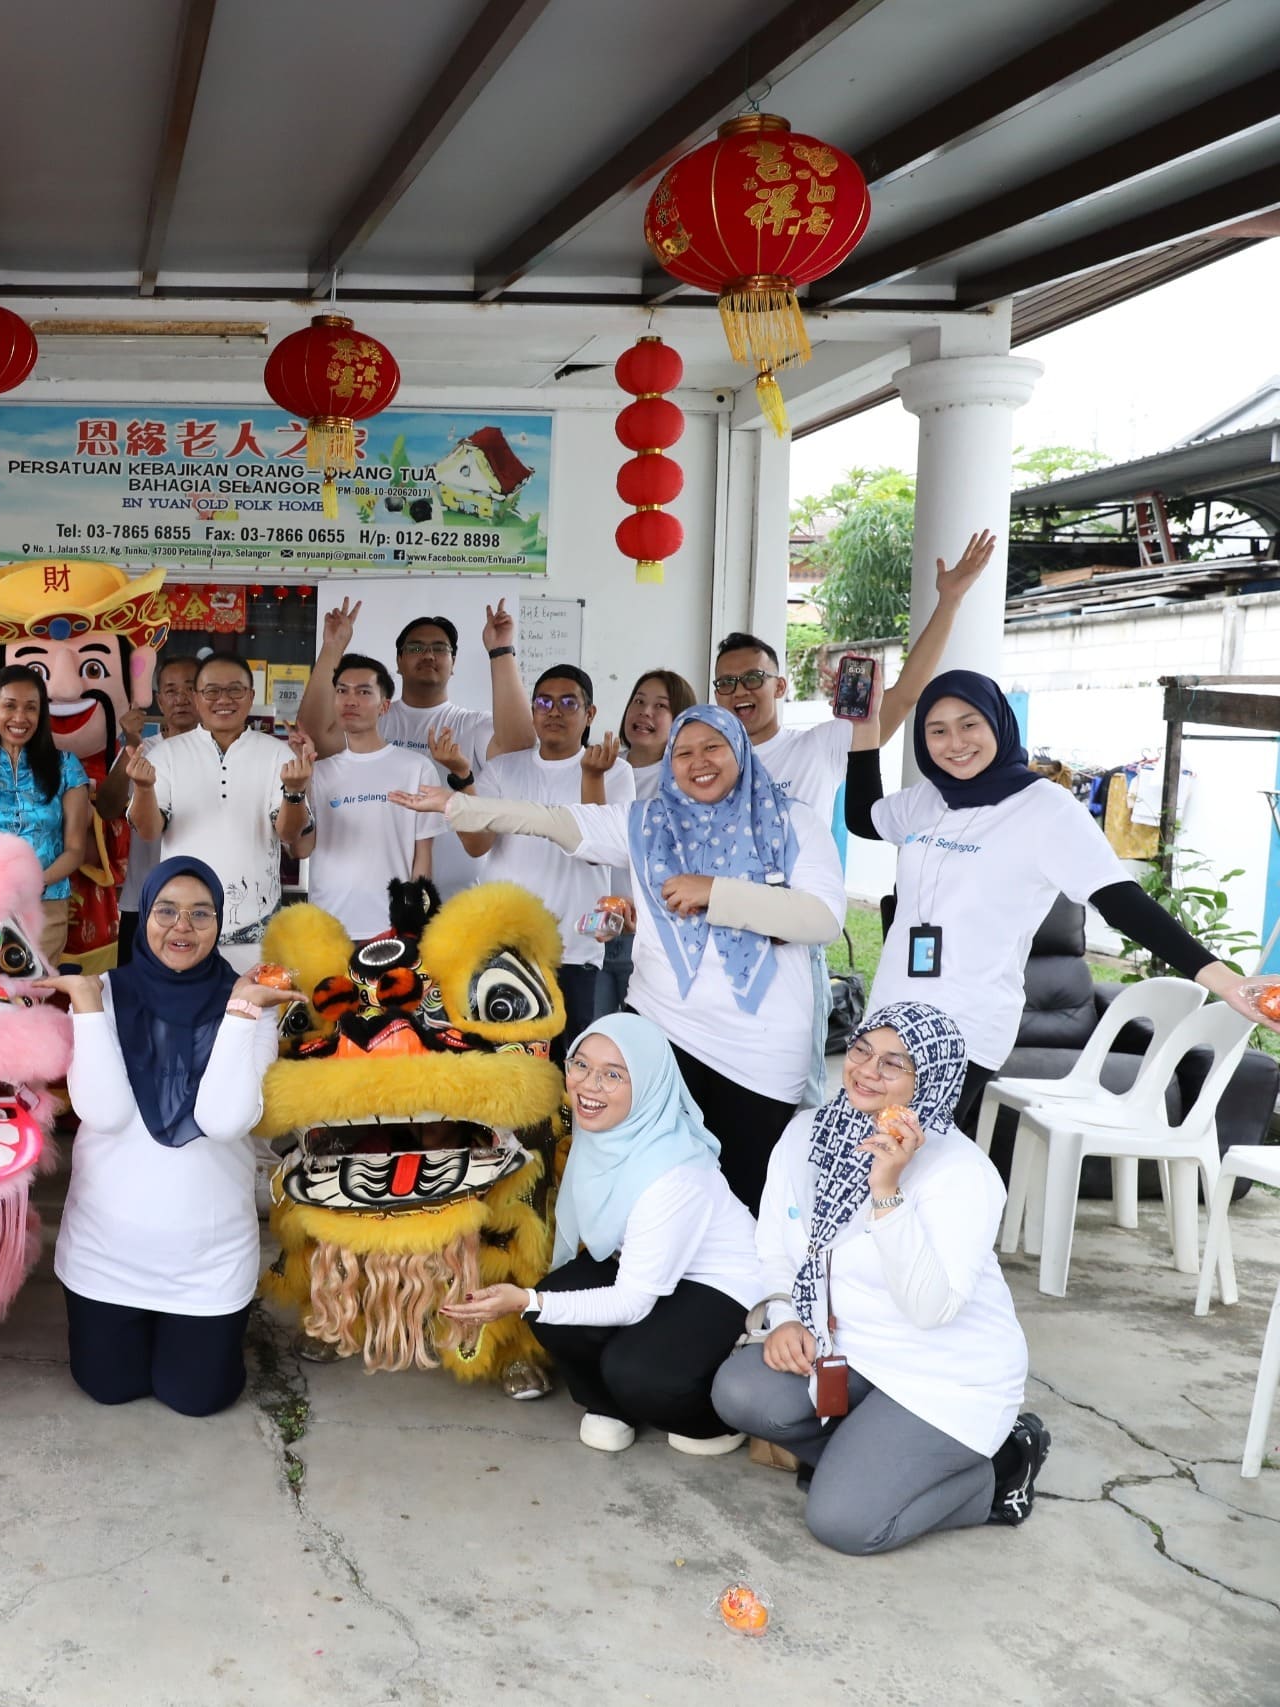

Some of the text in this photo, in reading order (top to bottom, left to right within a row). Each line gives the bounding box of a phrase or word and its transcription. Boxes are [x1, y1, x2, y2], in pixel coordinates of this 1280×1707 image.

[76, 420, 368, 459] 恩緣老人之
[8, 460, 122, 475] PERSATUAN
[128, 462, 229, 477] KEBAJIKAN
[399, 467, 437, 482] TUA
[128, 478, 212, 493] BAHAGIA
[218, 480, 321, 495] SELANGOR
[121, 497, 325, 512] EN YUAN OLD FOLK HOME
[55, 523, 501, 547] Tel: 03-7865 6855 Fax: 03-7866 0655 H/p: 012-622 8898
[33, 545, 46, 553] No.
[57, 545, 79, 554] Jalan
[80, 545, 92, 554] SS
[125, 546, 151, 556] Tunku,
[152, 547, 177, 556] 47300
[179, 547, 212, 558] Petaling
[235, 549, 271, 560] Selangor
[296, 551, 386, 561] enyuanpj@gmail.com
[43, 563, 71, 593] 財
[279, 690, 298, 699] 2025
[392, 740, 430, 750] Air Selan
[343, 791, 388, 804] Air Selang
